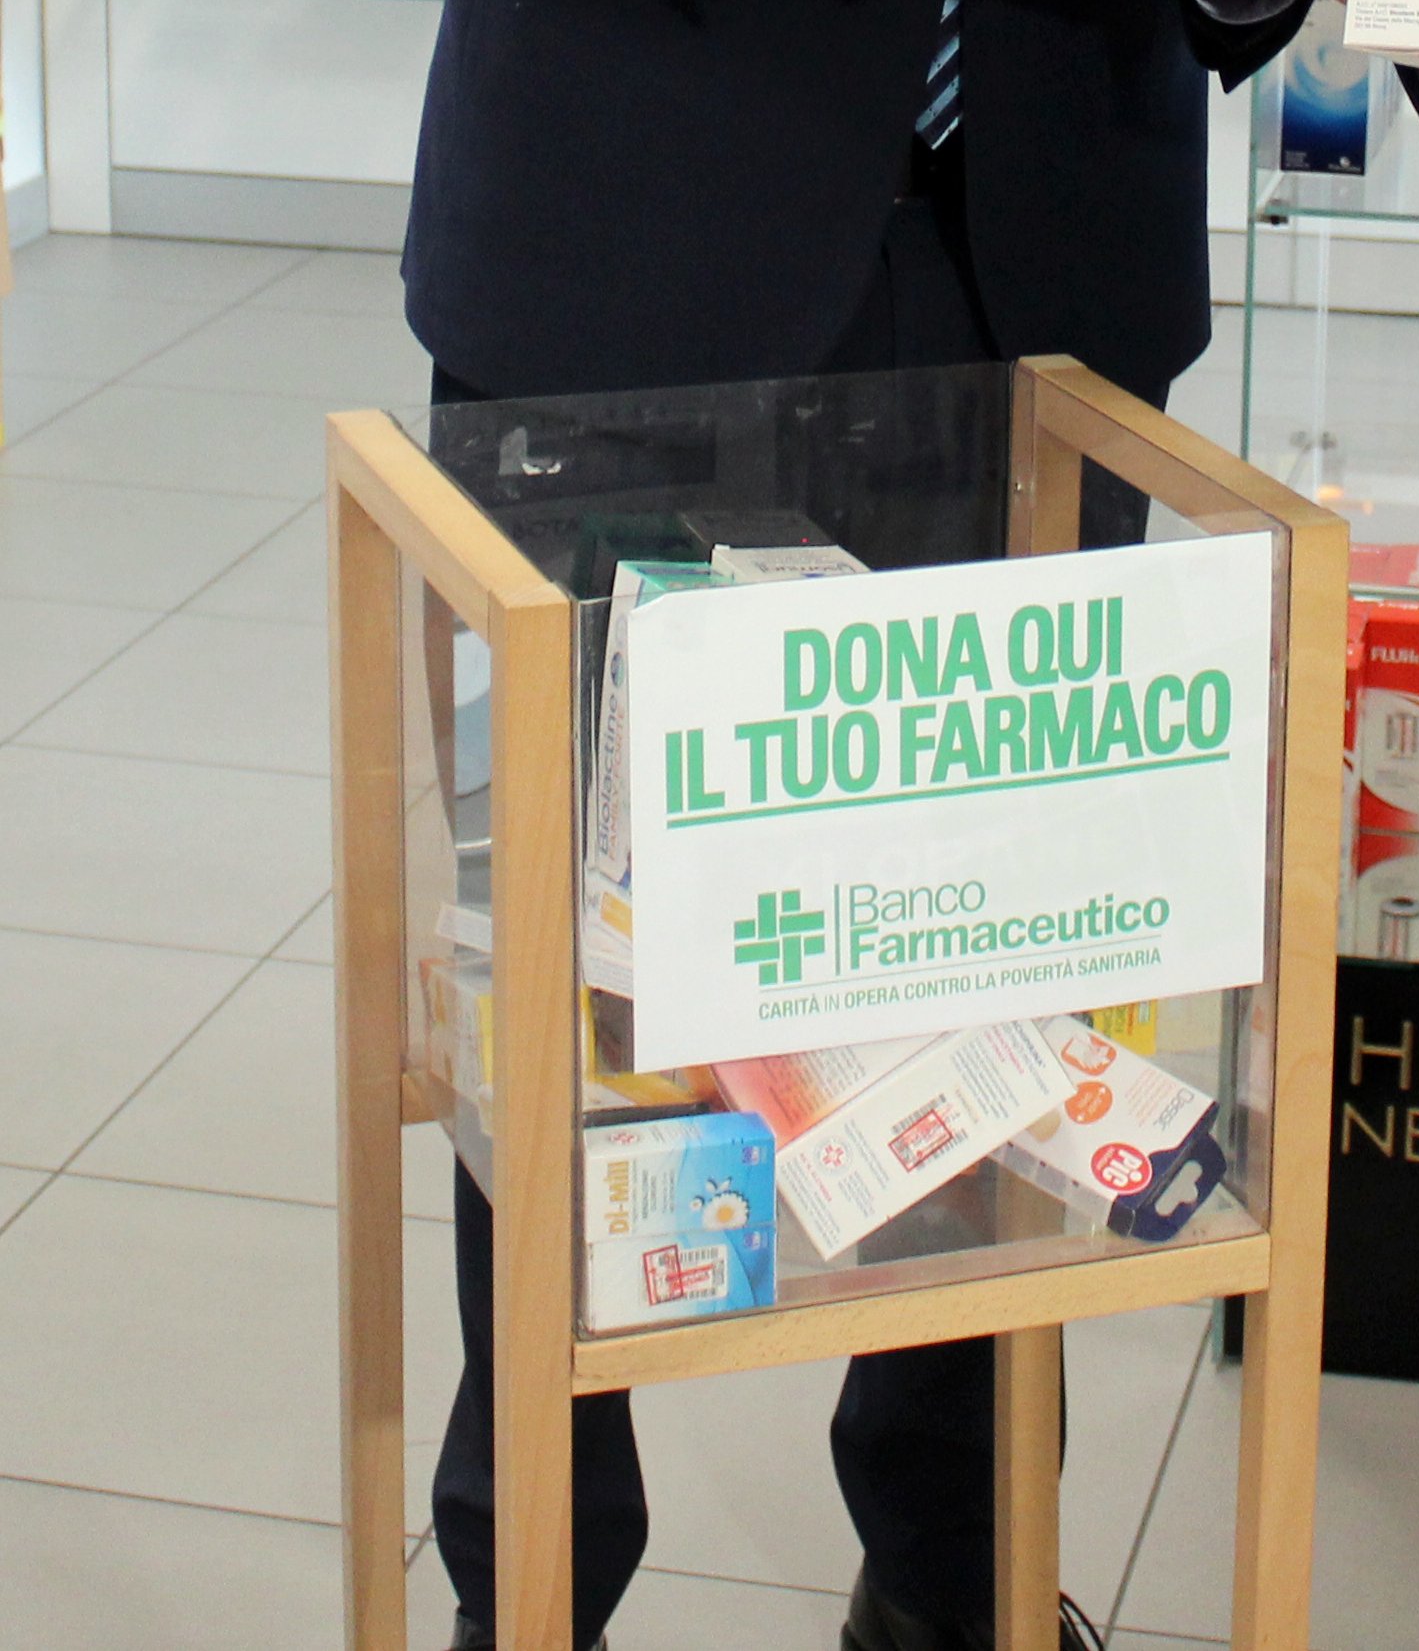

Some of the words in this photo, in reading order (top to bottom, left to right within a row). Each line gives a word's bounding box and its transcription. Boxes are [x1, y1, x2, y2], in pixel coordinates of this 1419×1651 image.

[783, 611, 994, 712] DONA
[1007, 596, 1123, 688] QUI
[599, 693, 618, 856] Biolactine
[665, 728, 726, 814] IL
[734, 710, 881, 803] TUO
[899, 668, 1232, 787] FARMACO
[848, 879, 987, 927] Banco
[849, 892, 1171, 971] Farmaceutico
[758, 993, 821, 1021] CARITÀ
[823, 993, 841, 1013] IN
[843, 984, 901, 1010] OPERA
[902, 976, 971, 1003] CONTRO
[975, 972, 997, 992] LA
[1000, 956, 1074, 988] POVERTÀ
[1077, 946, 1163, 977] SANITARIA
